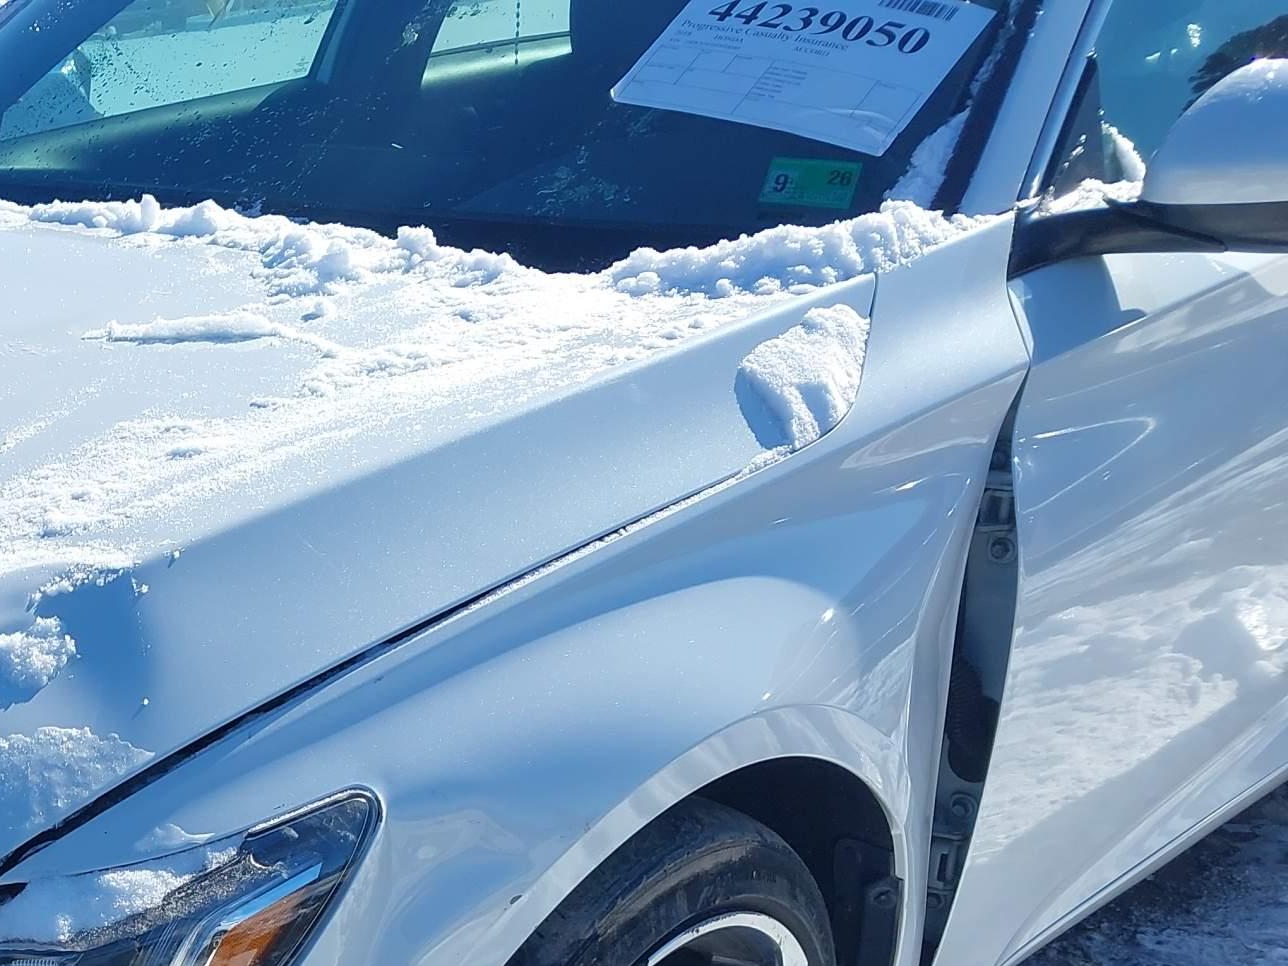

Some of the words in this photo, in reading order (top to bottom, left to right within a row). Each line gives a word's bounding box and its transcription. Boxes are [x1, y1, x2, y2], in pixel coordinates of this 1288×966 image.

[681, 20, 741, 34] Progressive
[745, 28, 791, 42] Casualty
[794, 34, 850, 51] Insurance
[708, 0, 930, 54] 44239050
[774, 173, 789, 193] 9
